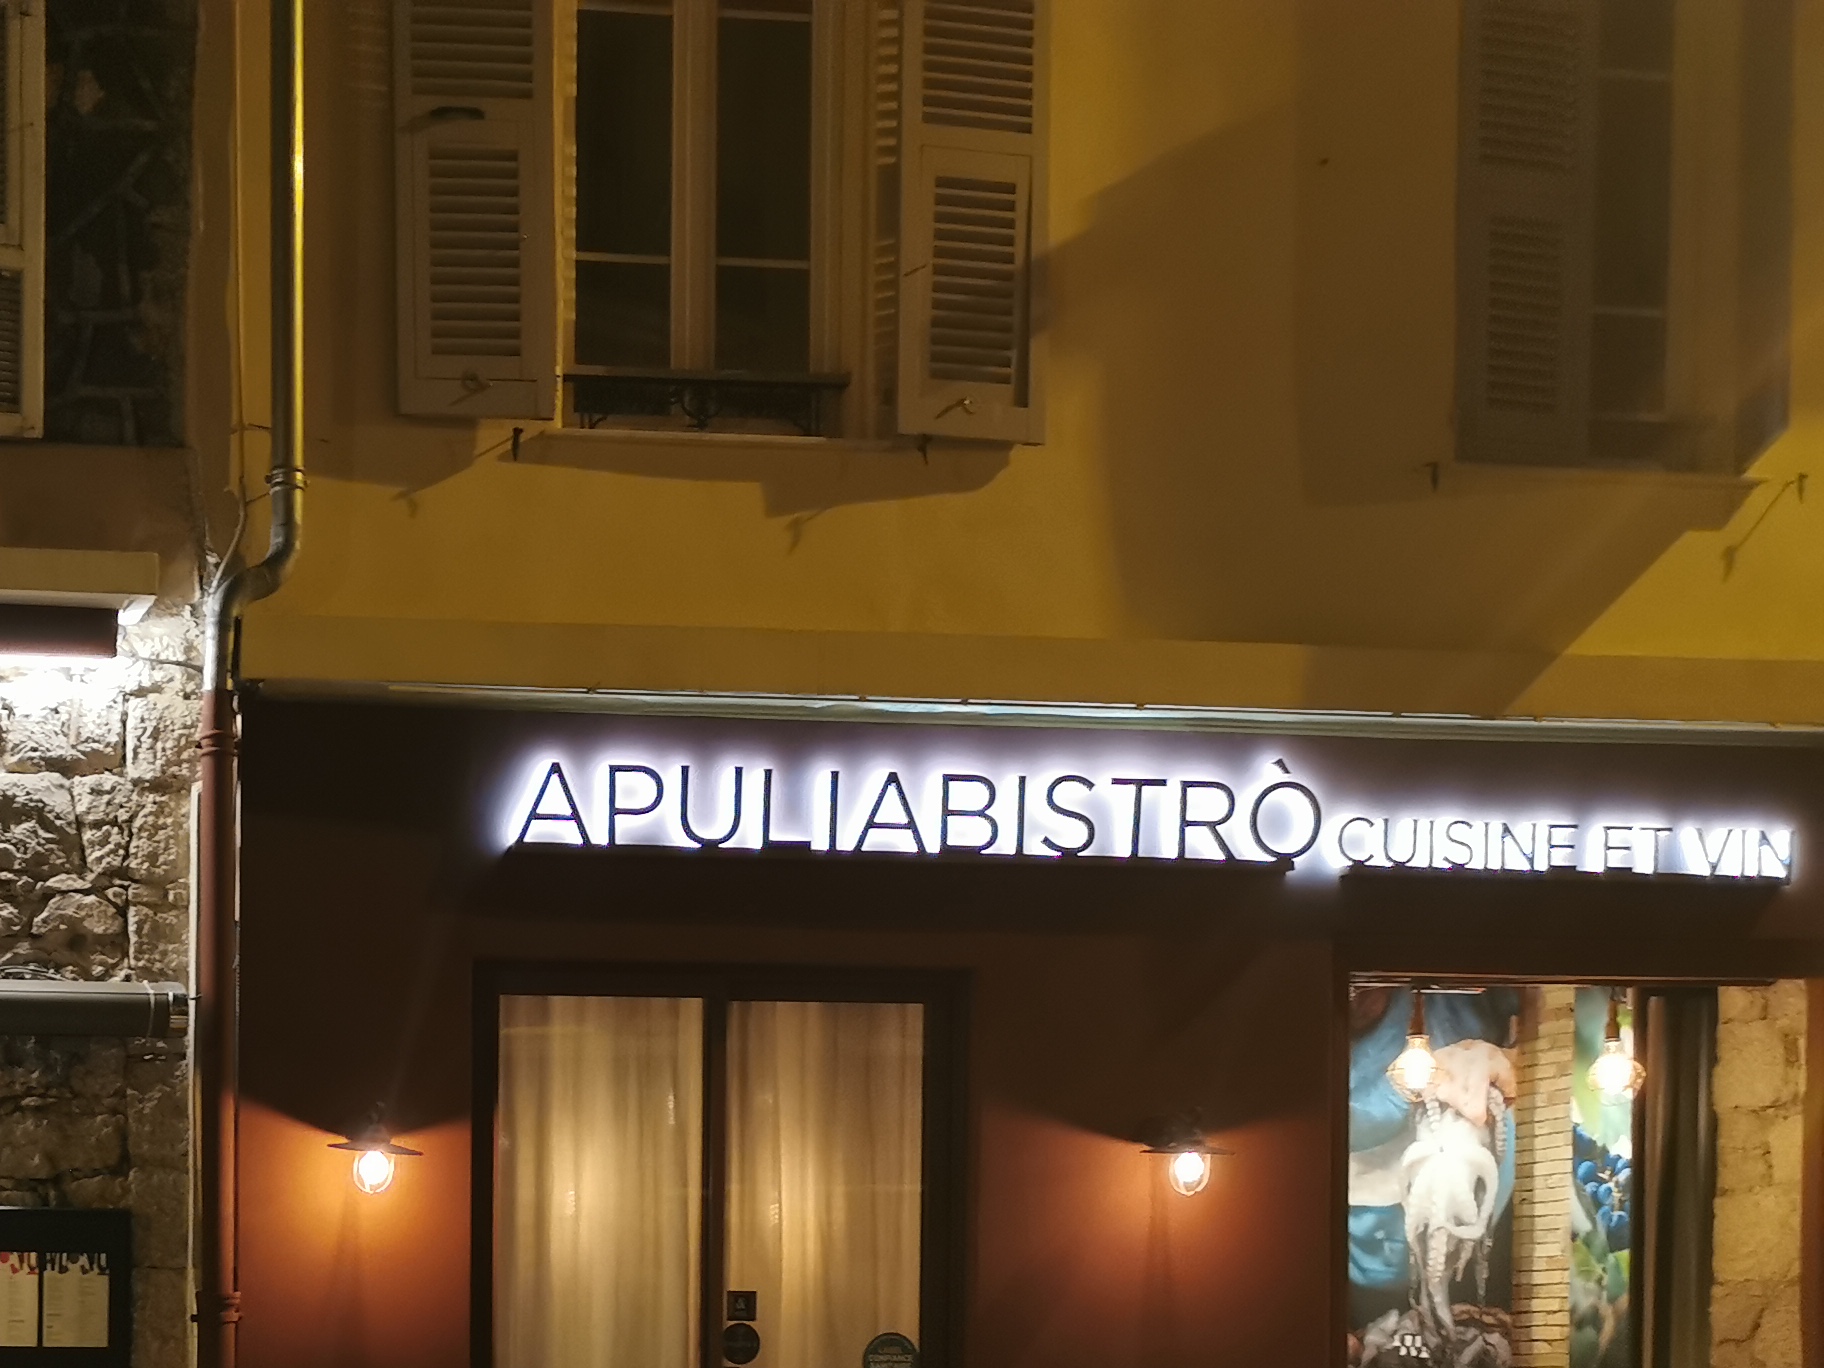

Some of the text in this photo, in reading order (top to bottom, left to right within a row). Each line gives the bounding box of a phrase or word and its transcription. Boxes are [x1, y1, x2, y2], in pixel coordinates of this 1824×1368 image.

[515, 757, 1797, 884] APULIABISTRÒ CUISINE ET VIN
